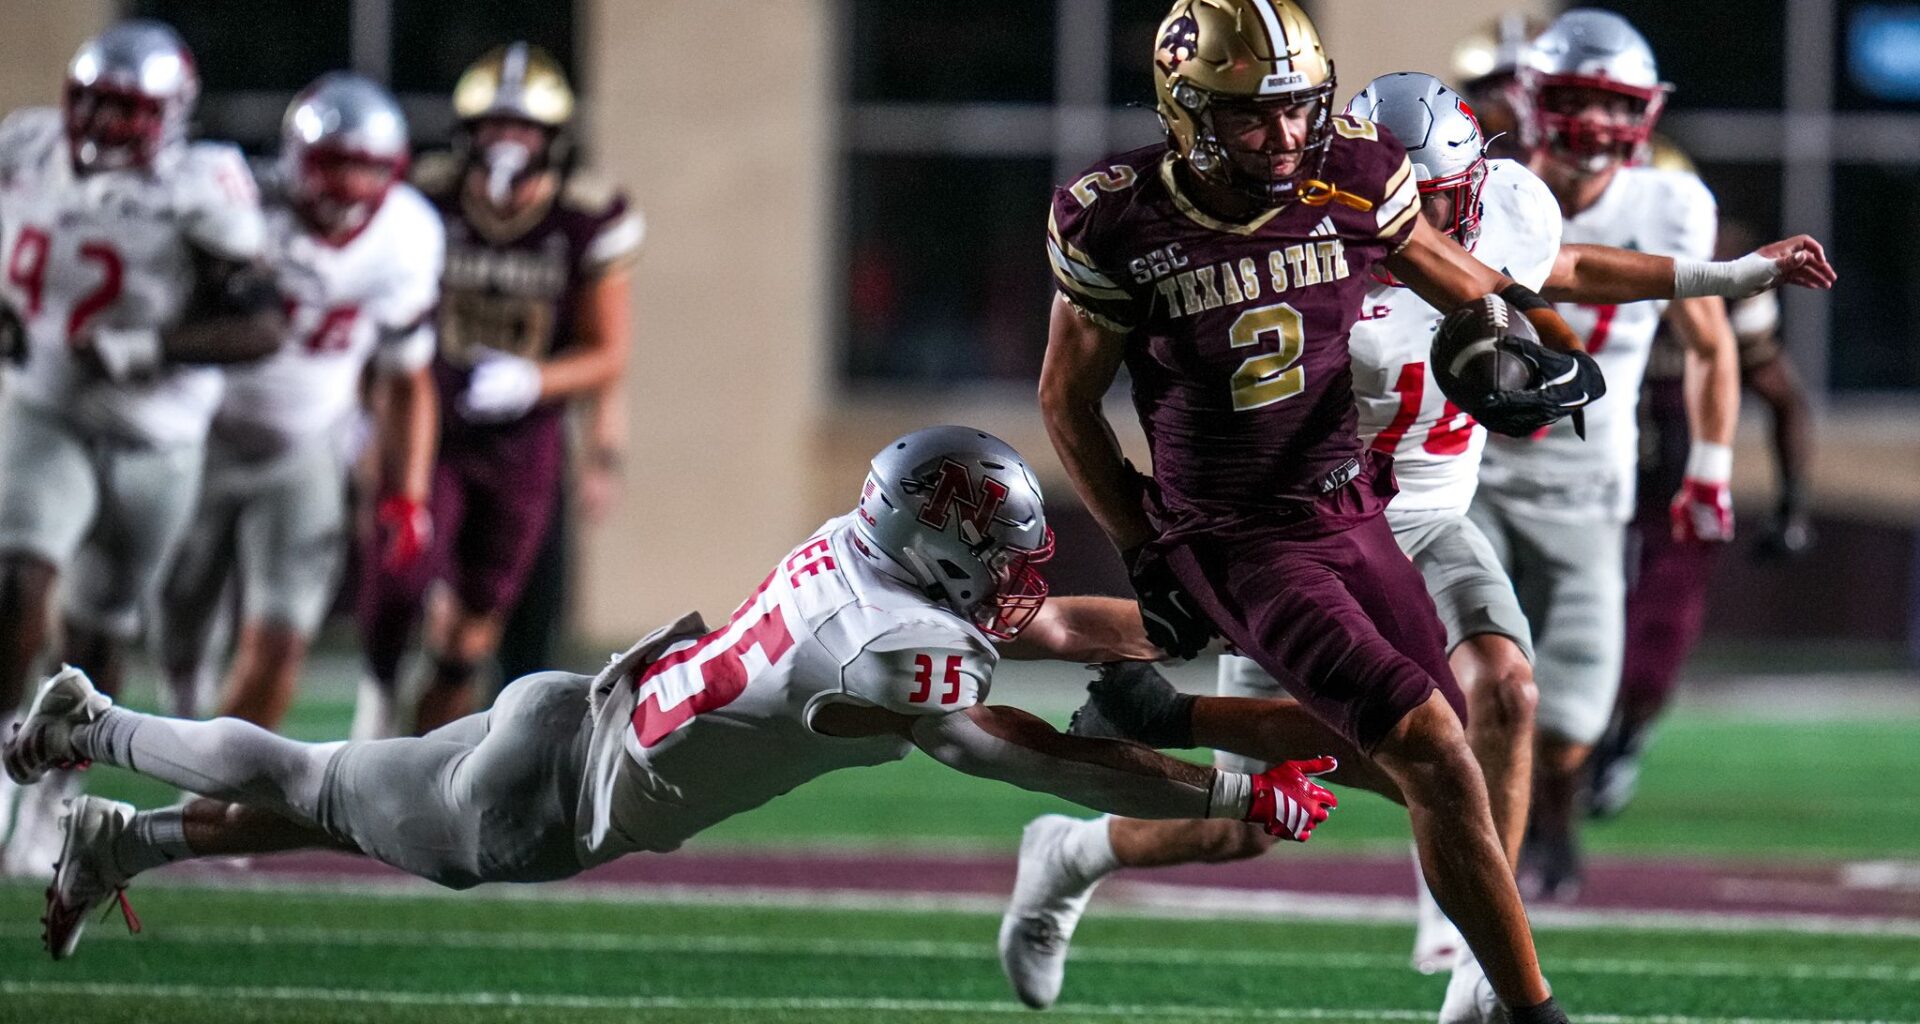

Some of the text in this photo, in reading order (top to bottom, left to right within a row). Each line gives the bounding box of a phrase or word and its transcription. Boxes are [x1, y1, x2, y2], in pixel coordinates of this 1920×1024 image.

[1069, 164, 1138, 209] 2
[9, 222, 124, 345] 92
[1127, 241, 1189, 285] SBC
[1156, 238, 1350, 319] TEXAS STATE
[1228, 302, 1305, 412] 2
[916, 455, 1011, 547] N
[786, 537, 837, 590] EE
[908, 653, 964, 706] 35
